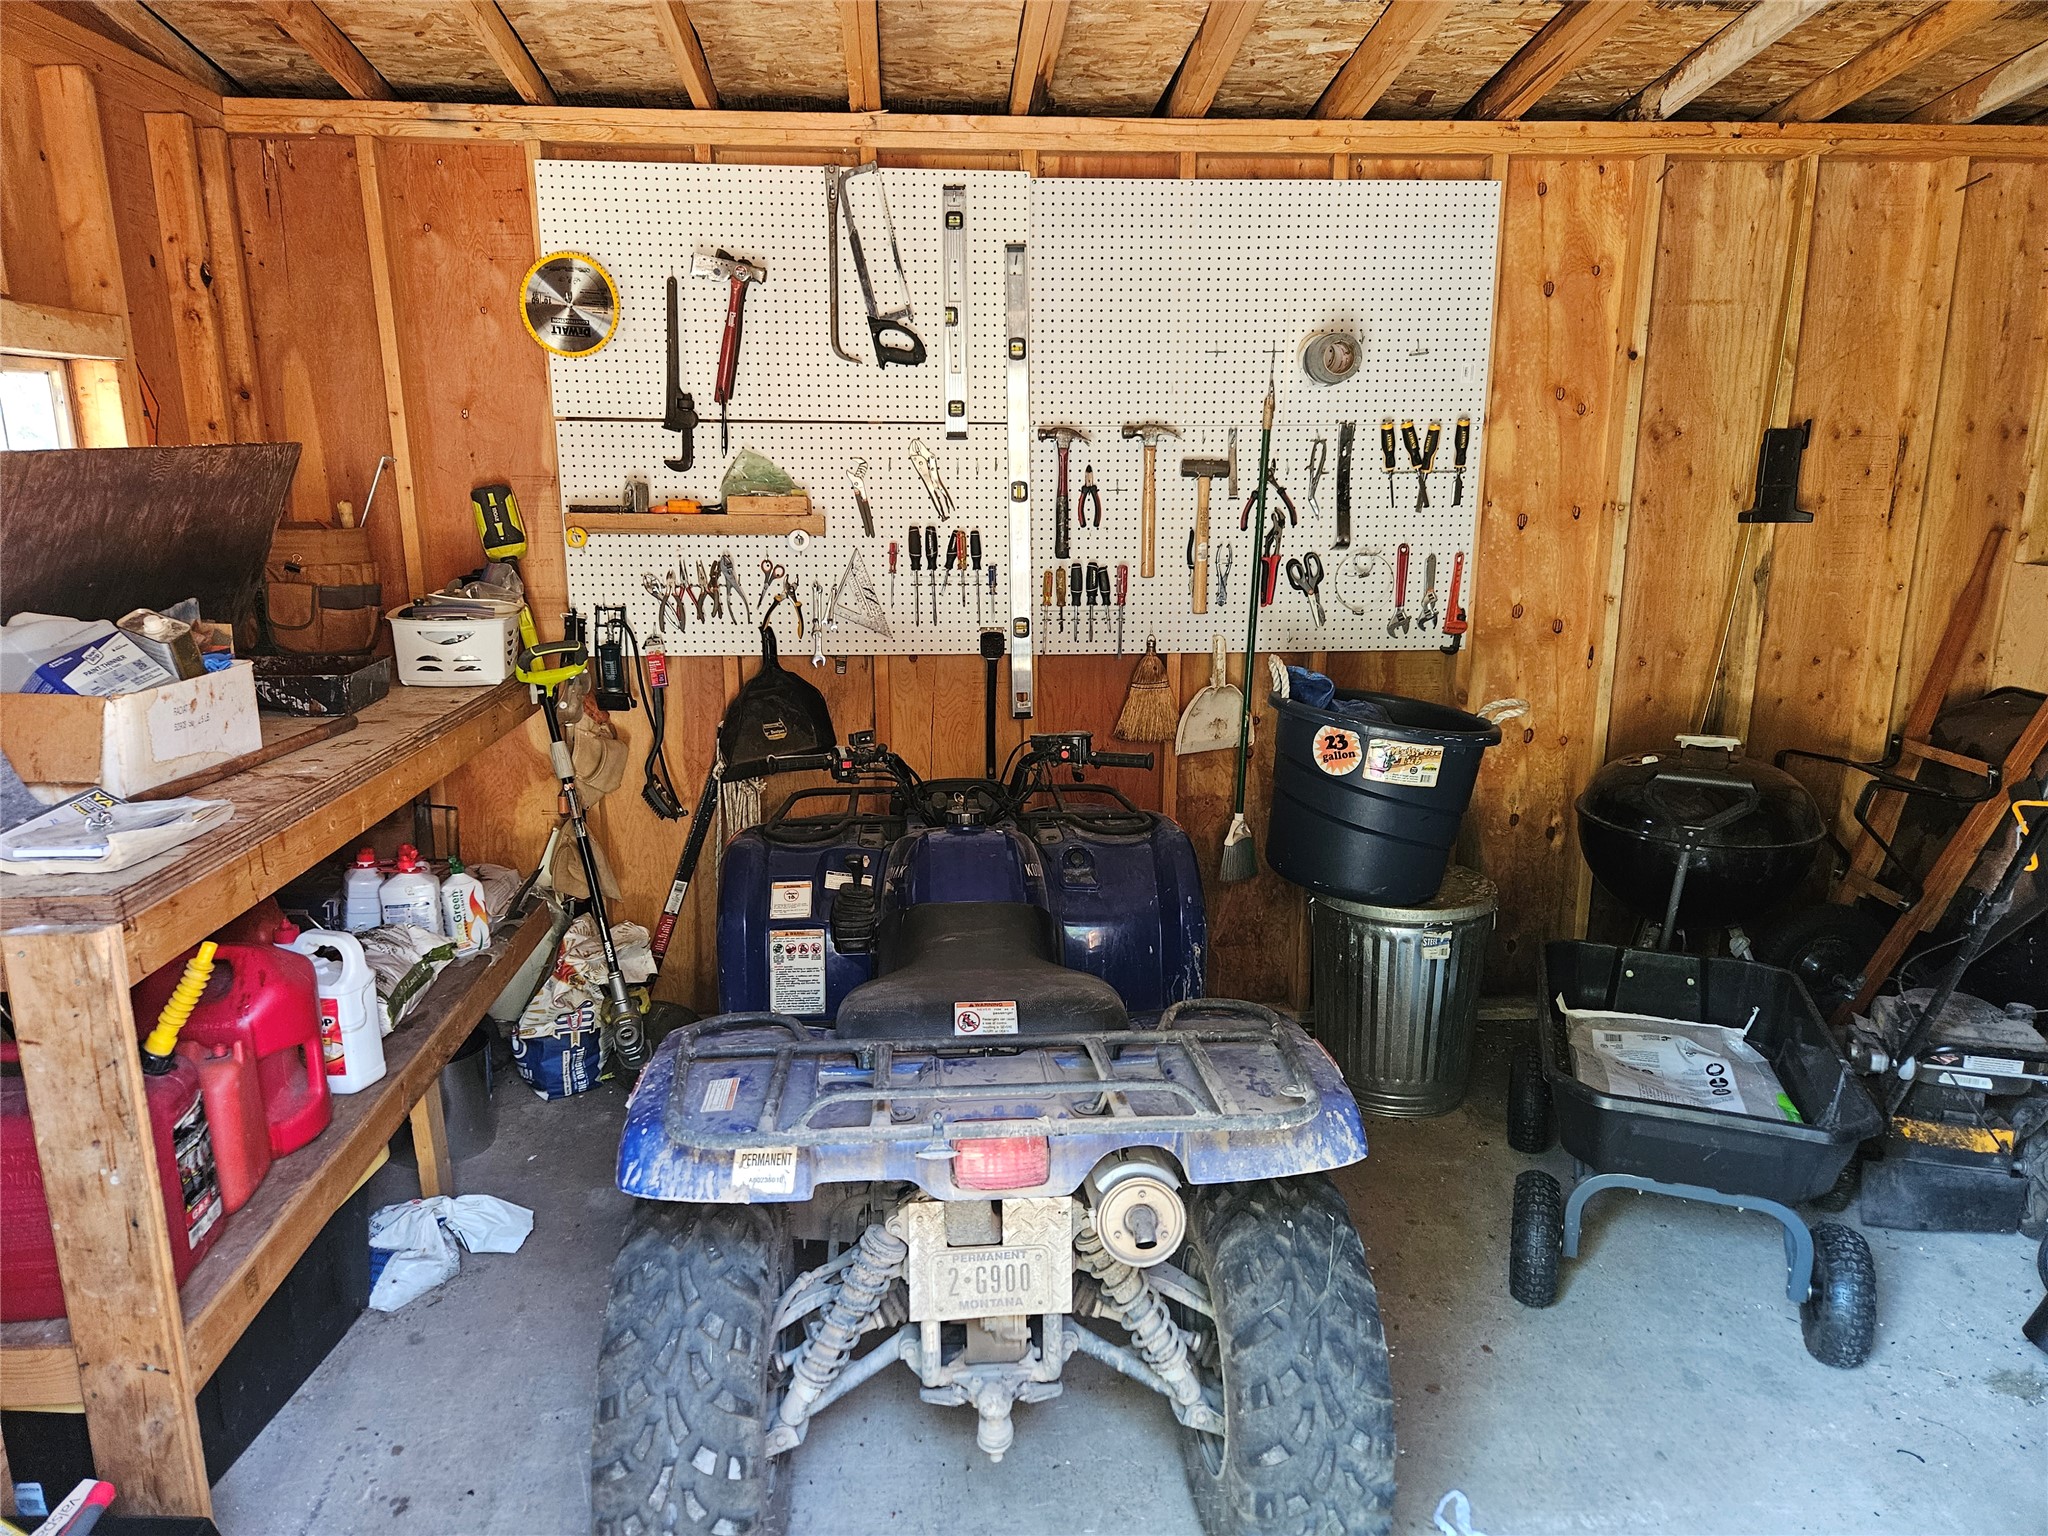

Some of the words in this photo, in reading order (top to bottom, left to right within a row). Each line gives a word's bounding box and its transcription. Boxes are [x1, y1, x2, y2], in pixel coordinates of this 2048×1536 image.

[551, 325, 592, 337] DEWALT
[1324, 733, 1349, 751] 23
[1322, 750, 1356, 764] gallon
[741, 1152, 793, 1168] PERMANENT
[952, 1250, 1028, 1263] PERMANENT
[958, 1297, 1024, 1311] MONTANA
